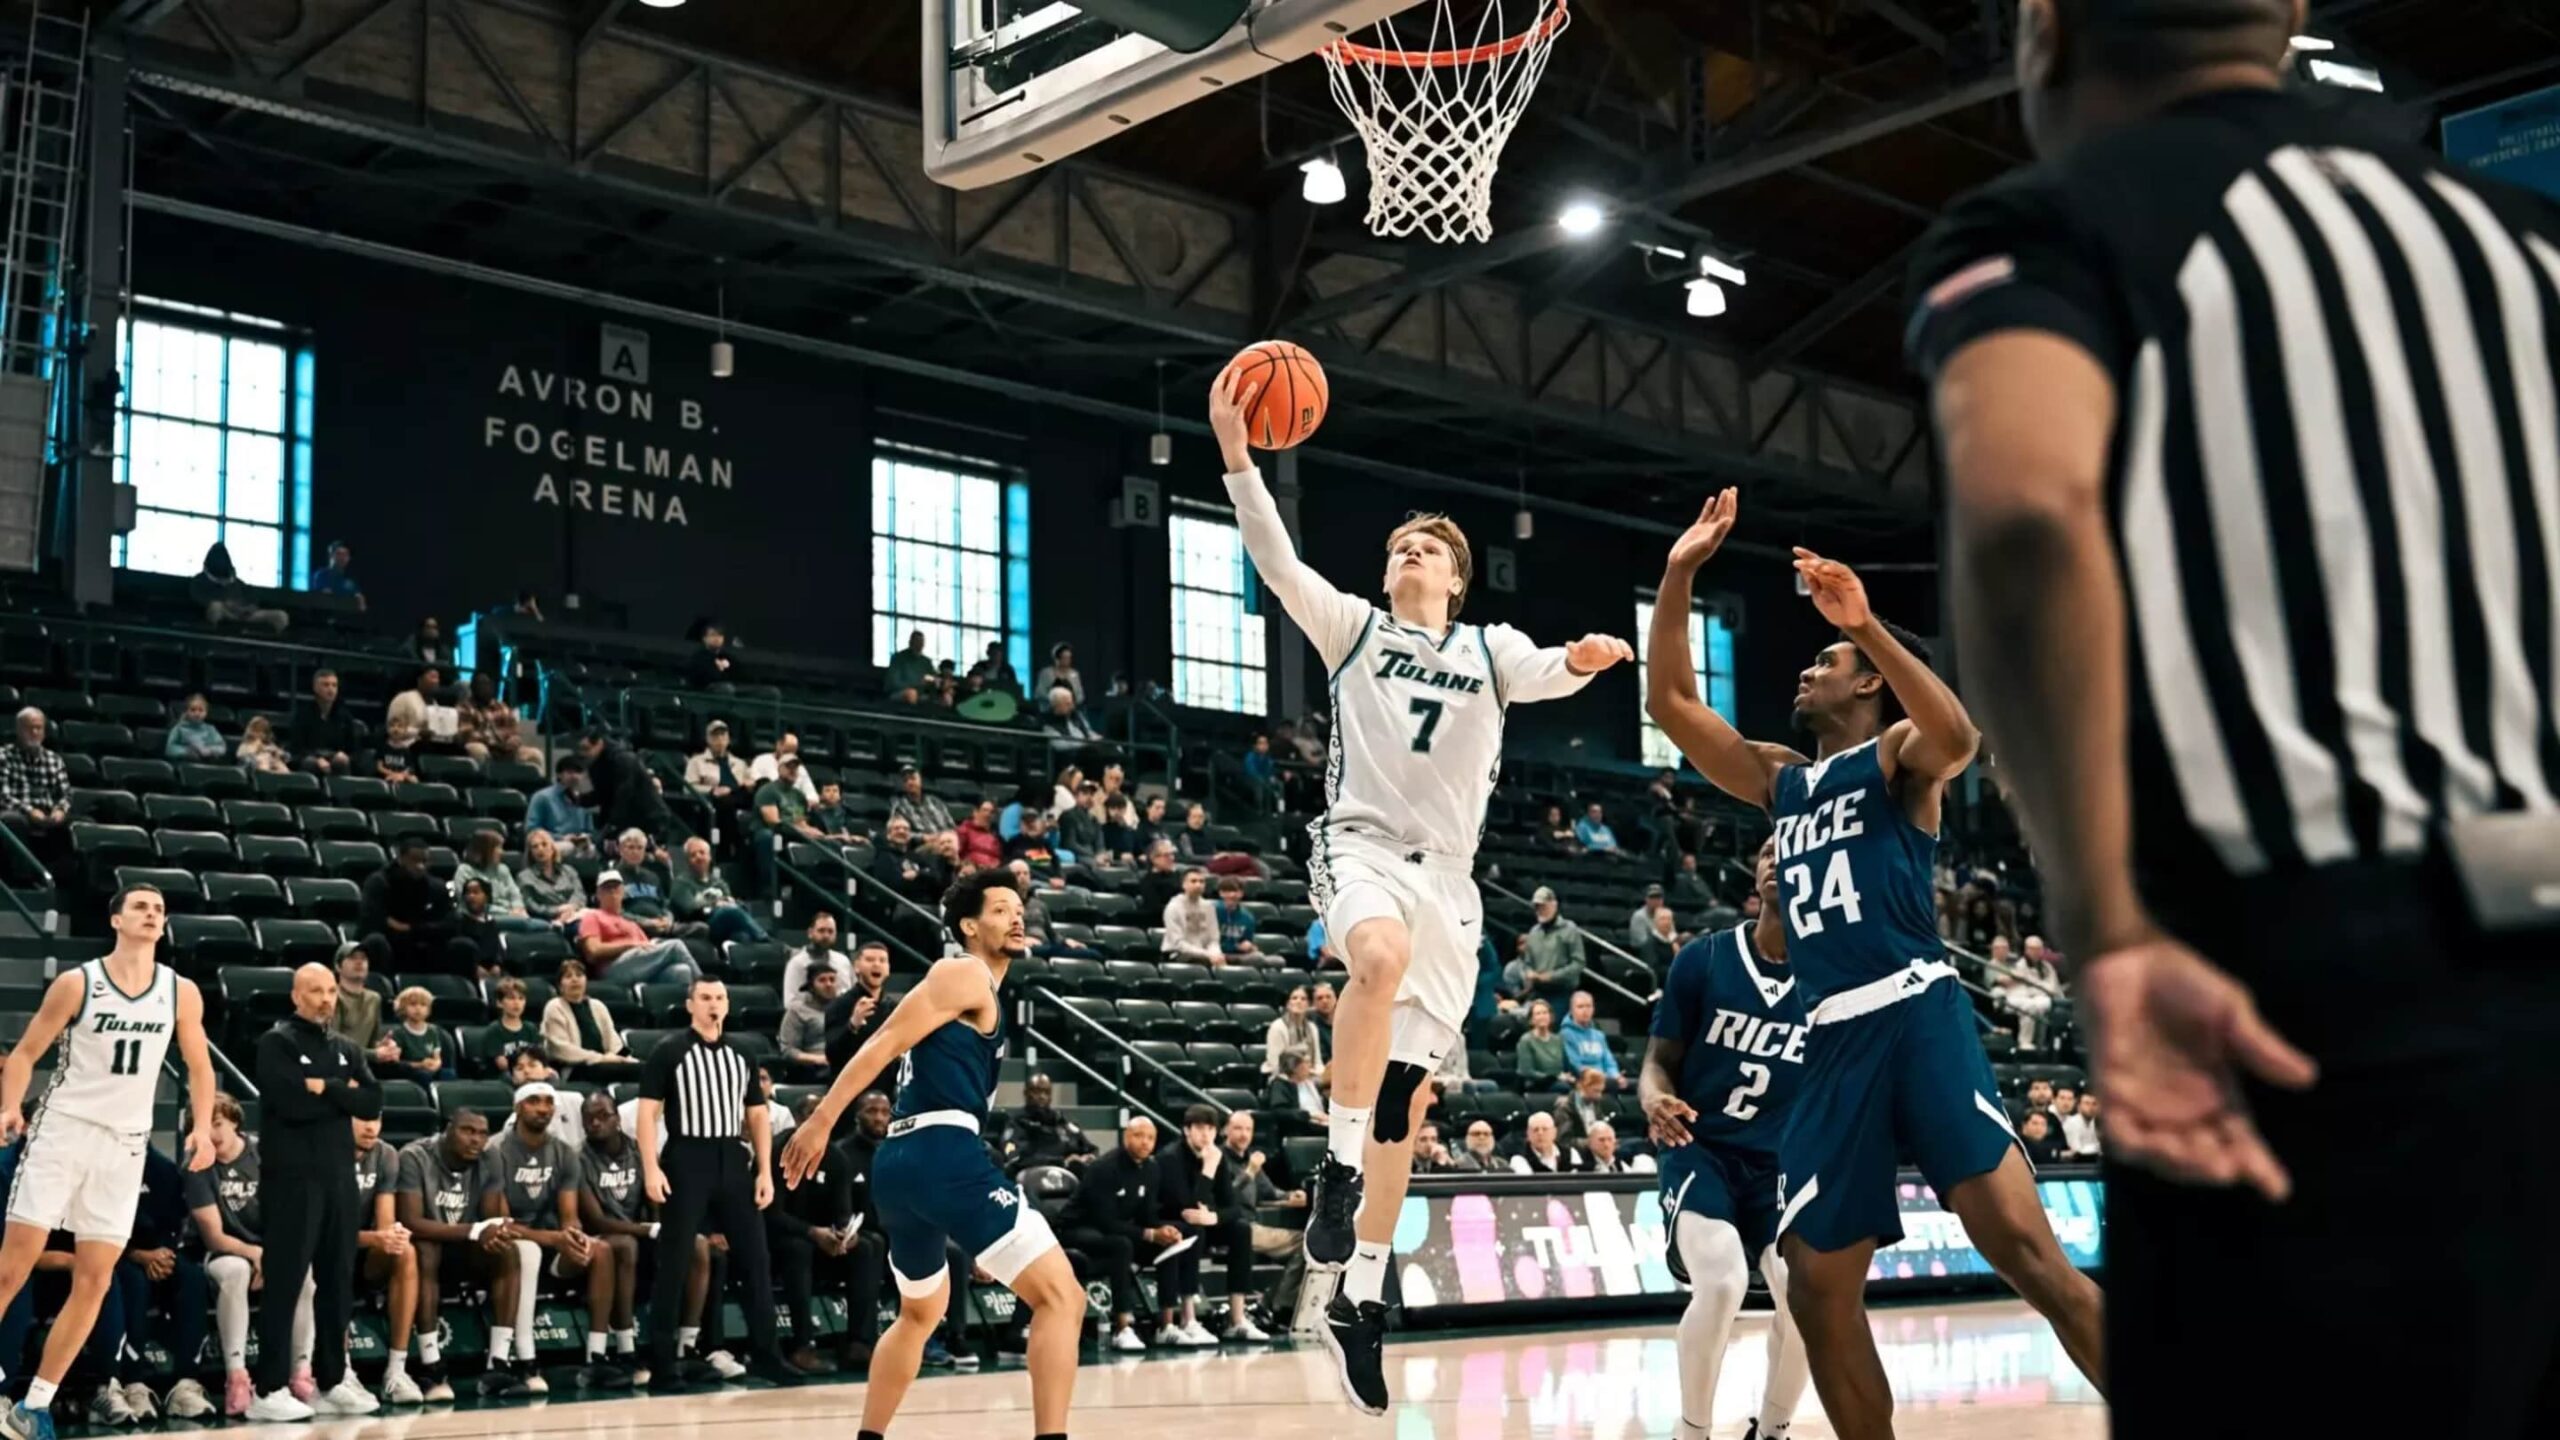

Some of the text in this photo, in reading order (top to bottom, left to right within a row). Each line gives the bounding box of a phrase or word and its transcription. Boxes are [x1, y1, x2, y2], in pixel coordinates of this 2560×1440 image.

[611, 344, 638, 377] A
[498, 364, 719, 434] AVRON B.
[485, 416, 733, 489] FOGELMAN
[533, 473, 688, 526] ARENA
[1134, 494, 1150, 520] B
[1495, 562, 1508, 587] C
[1375, 648, 1484, 694] TULANE
[1409, 697, 1444, 753] 7
[1774, 788, 1867, 865] RICE
[1784, 849, 1862, 940] 24
[92, 1012, 166, 1034] TULANE
[1704, 1008, 1809, 1064] RICE
[110, 1039, 142, 1075] 11
[1722, 1061, 1771, 1121] 2
[982, 1290, 1017, 1308] plan
